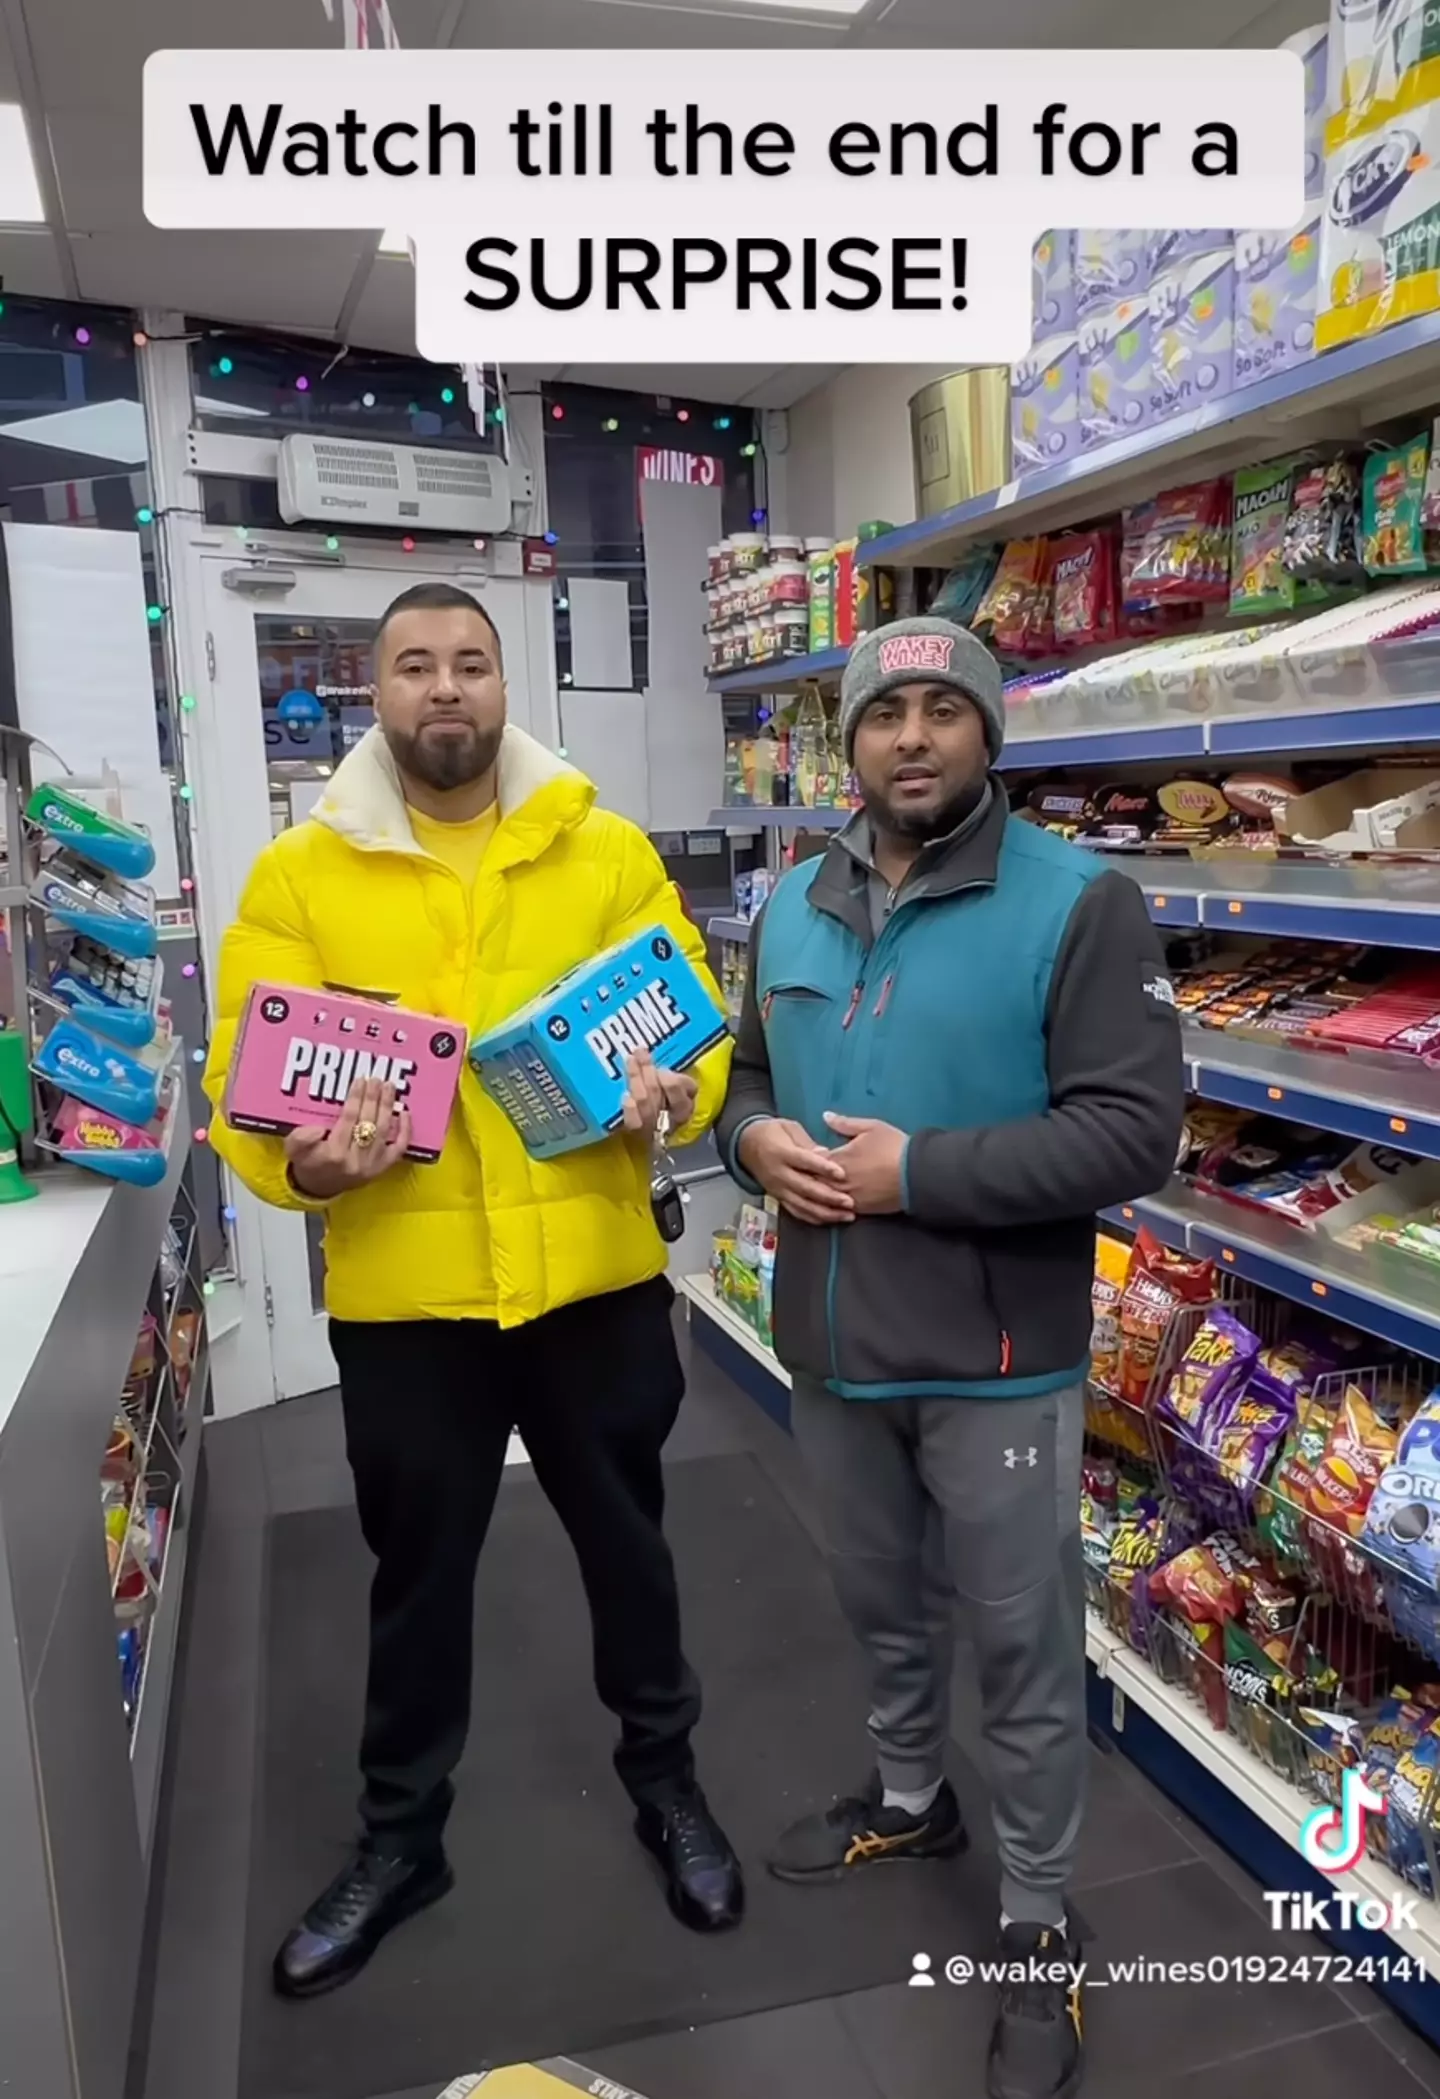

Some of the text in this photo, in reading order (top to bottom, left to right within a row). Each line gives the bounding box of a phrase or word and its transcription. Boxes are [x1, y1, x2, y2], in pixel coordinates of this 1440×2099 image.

[881, 637, 953, 652] WAKEY
[882, 650, 946, 670] WINES
[43, 803, 84, 833] extra
[46, 885, 88, 914] extra
[265, 1002, 285, 1018] 12
[549, 1020, 568, 1036] 12
[584, 977, 689, 1081] PRIME
[57, 1047, 100, 1077] extra
[508, 1066, 553, 1125] PRIME
[528, 1058, 576, 1119] PRIME
[490, 1076, 533, 1132] PRIME
